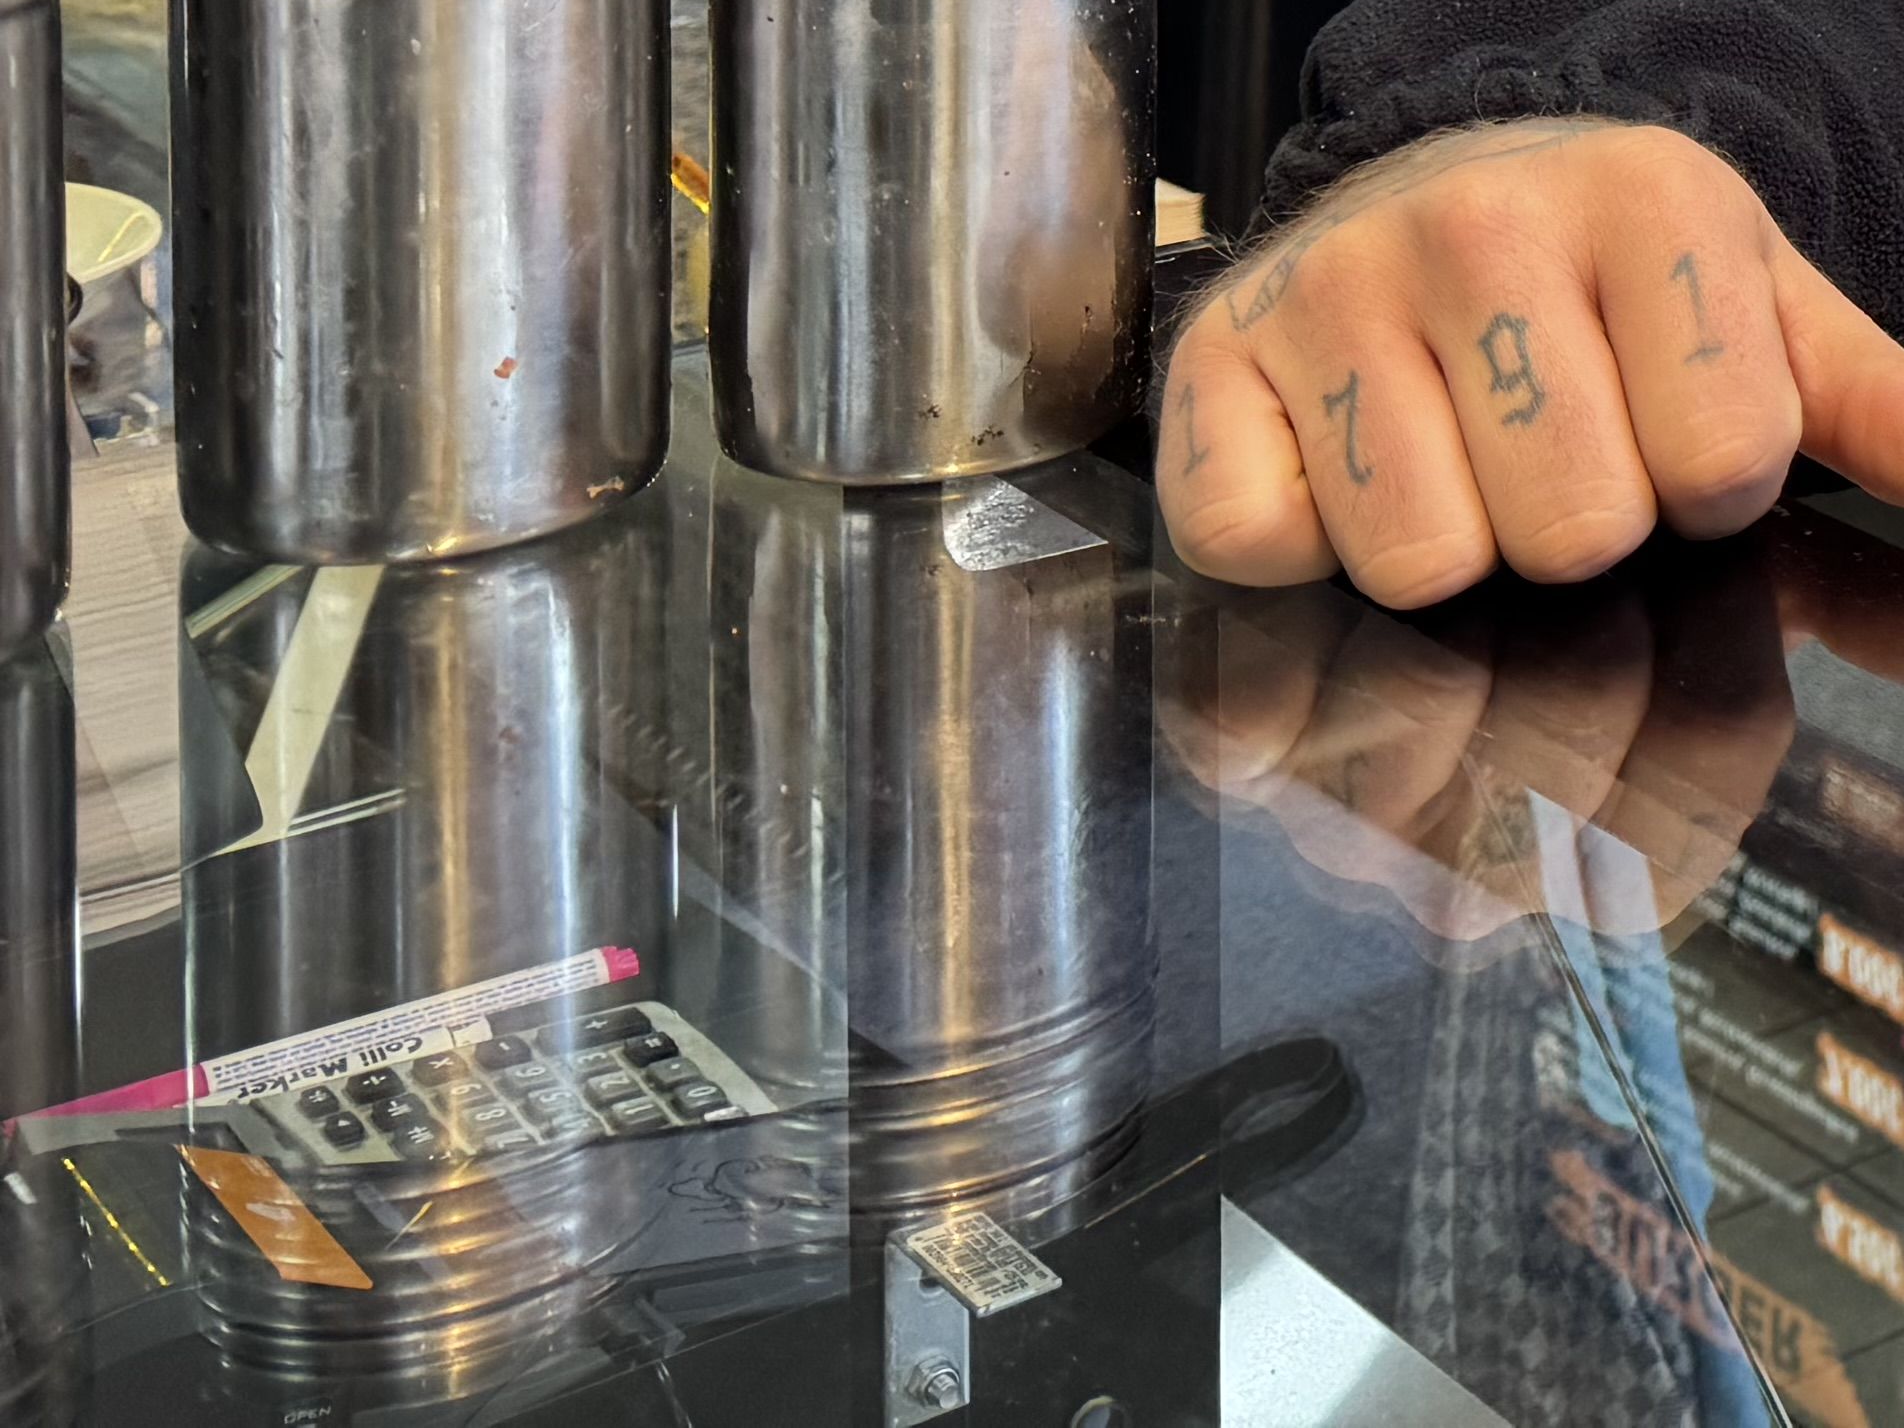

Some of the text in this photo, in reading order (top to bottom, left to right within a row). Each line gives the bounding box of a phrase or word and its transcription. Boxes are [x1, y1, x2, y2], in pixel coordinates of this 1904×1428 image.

[236, 1035, 423, 1101] Colli Marker
[283, 1405, 332, 1425] OPEN
